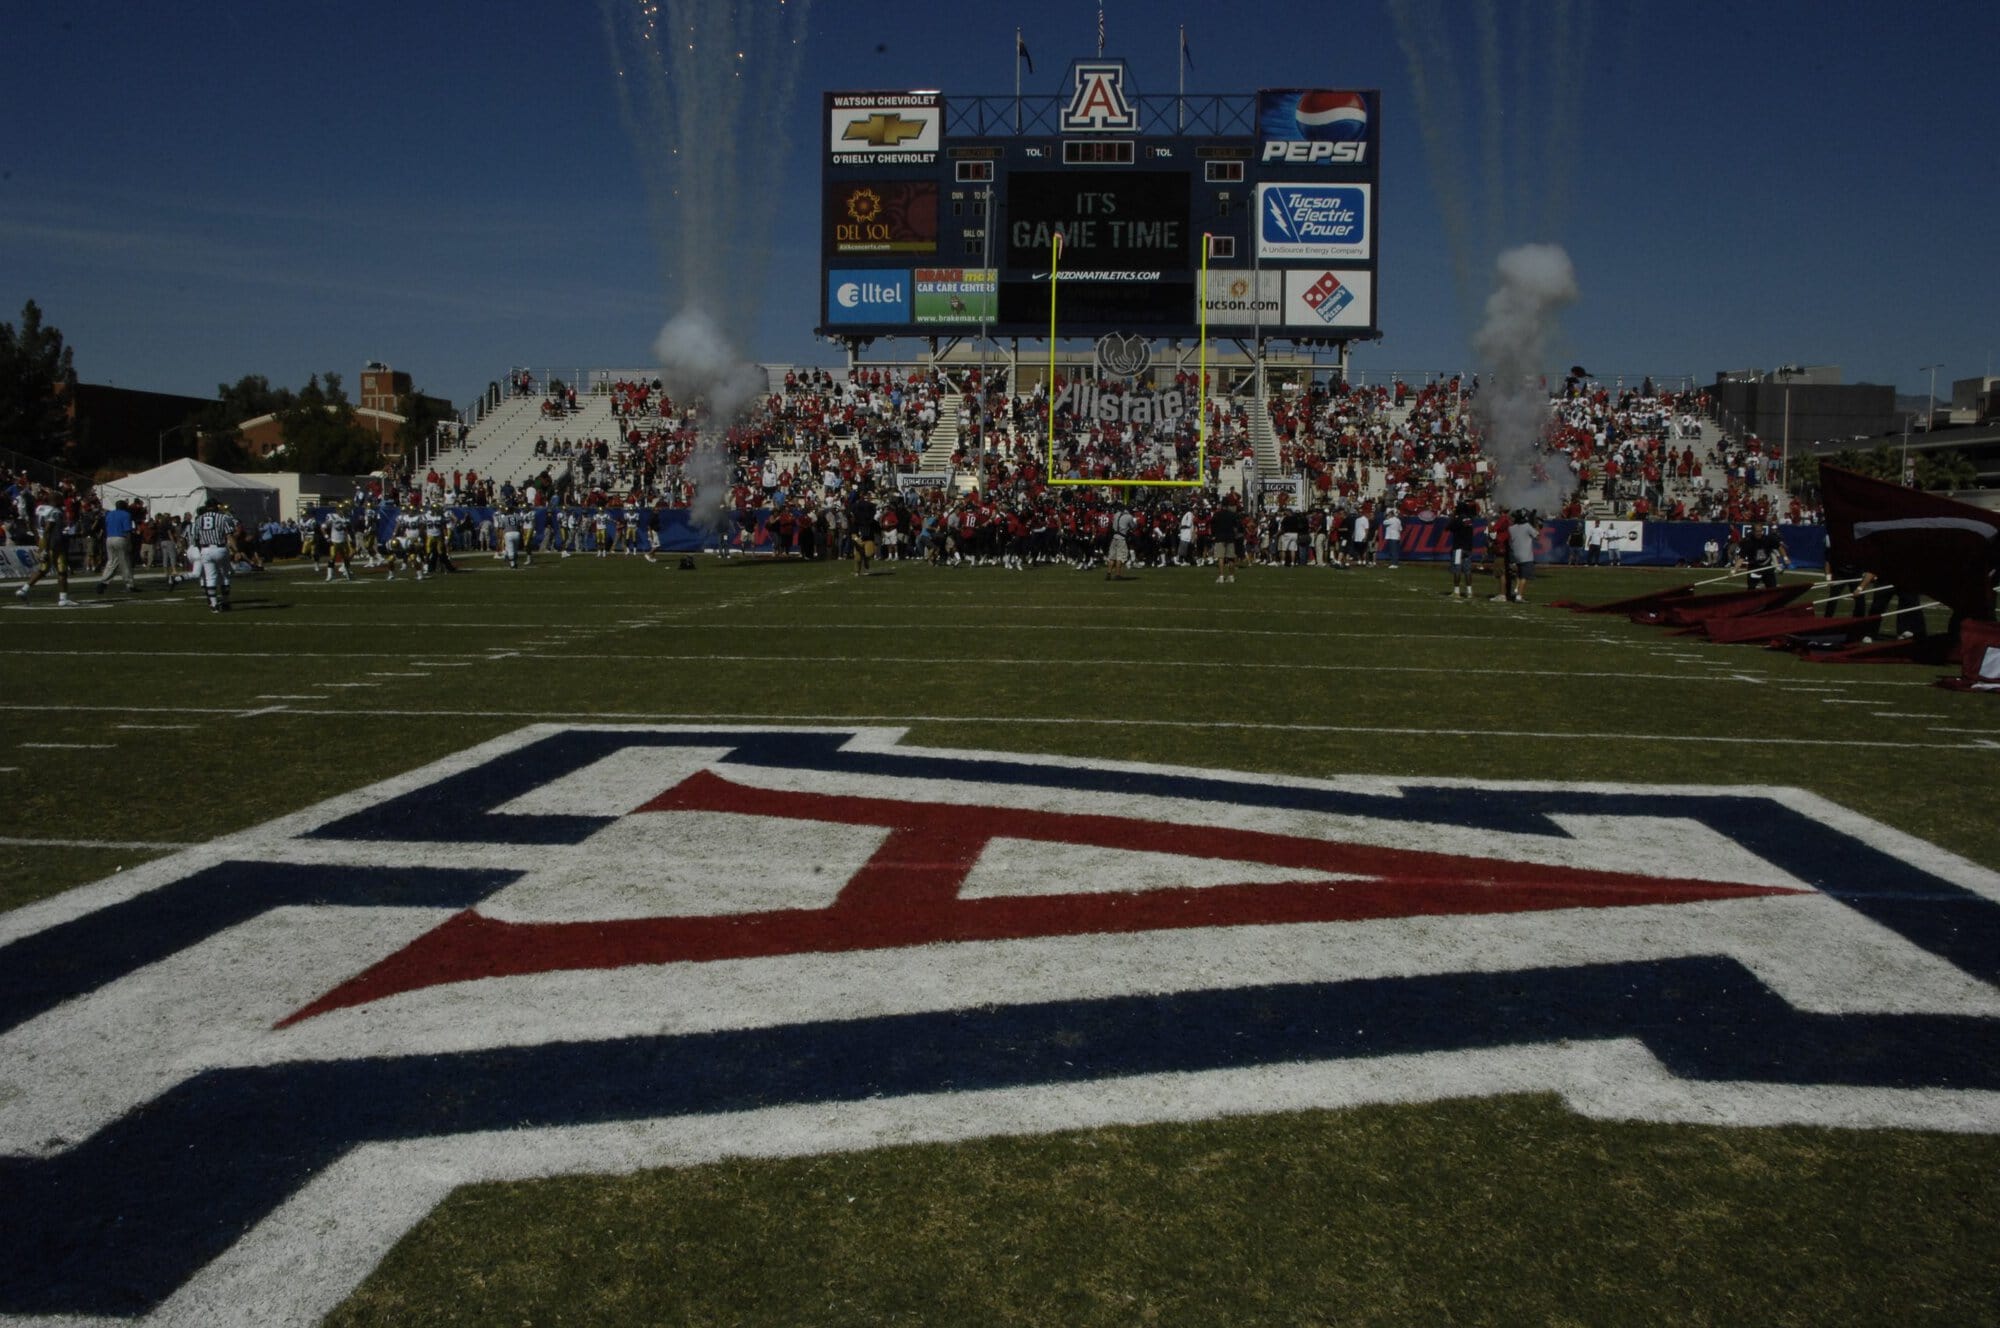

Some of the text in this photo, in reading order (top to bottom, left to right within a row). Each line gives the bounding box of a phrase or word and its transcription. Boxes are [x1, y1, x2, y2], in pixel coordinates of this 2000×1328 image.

[833, 95, 936, 106] WATSON CHEVROLET
[1066, 68, 1132, 131] A
[832, 153, 936, 164] O'RIELLY CHEVROLET
[1025, 148, 1043, 157] TOL
[1155, 148, 1172, 157] TOL
[1261, 141, 1368, 163] PEPSI
[1076, 192, 1117, 215] IT'S
[1288, 193, 1341, 208] Tucson
[1293, 208, 1355, 222] Electric
[836, 224, 892, 240] DEL SOL
[1012, 221, 1179, 248] GAME TIME
[1299, 222, 1355, 236] Power
[1305, 247, 1330, 255] Energy
[1330, 247, 1364, 255] Company
[1048, 271, 1161, 281] ARIZONAATHLETICS.COM
[844, 282, 902, 305] alltel
[917, 283, 934, 292] CAR
[936, 283, 957, 292] CARE
[1200, 299, 1279, 311] ucson.com
[1053, 381, 1184, 424] Allstate
